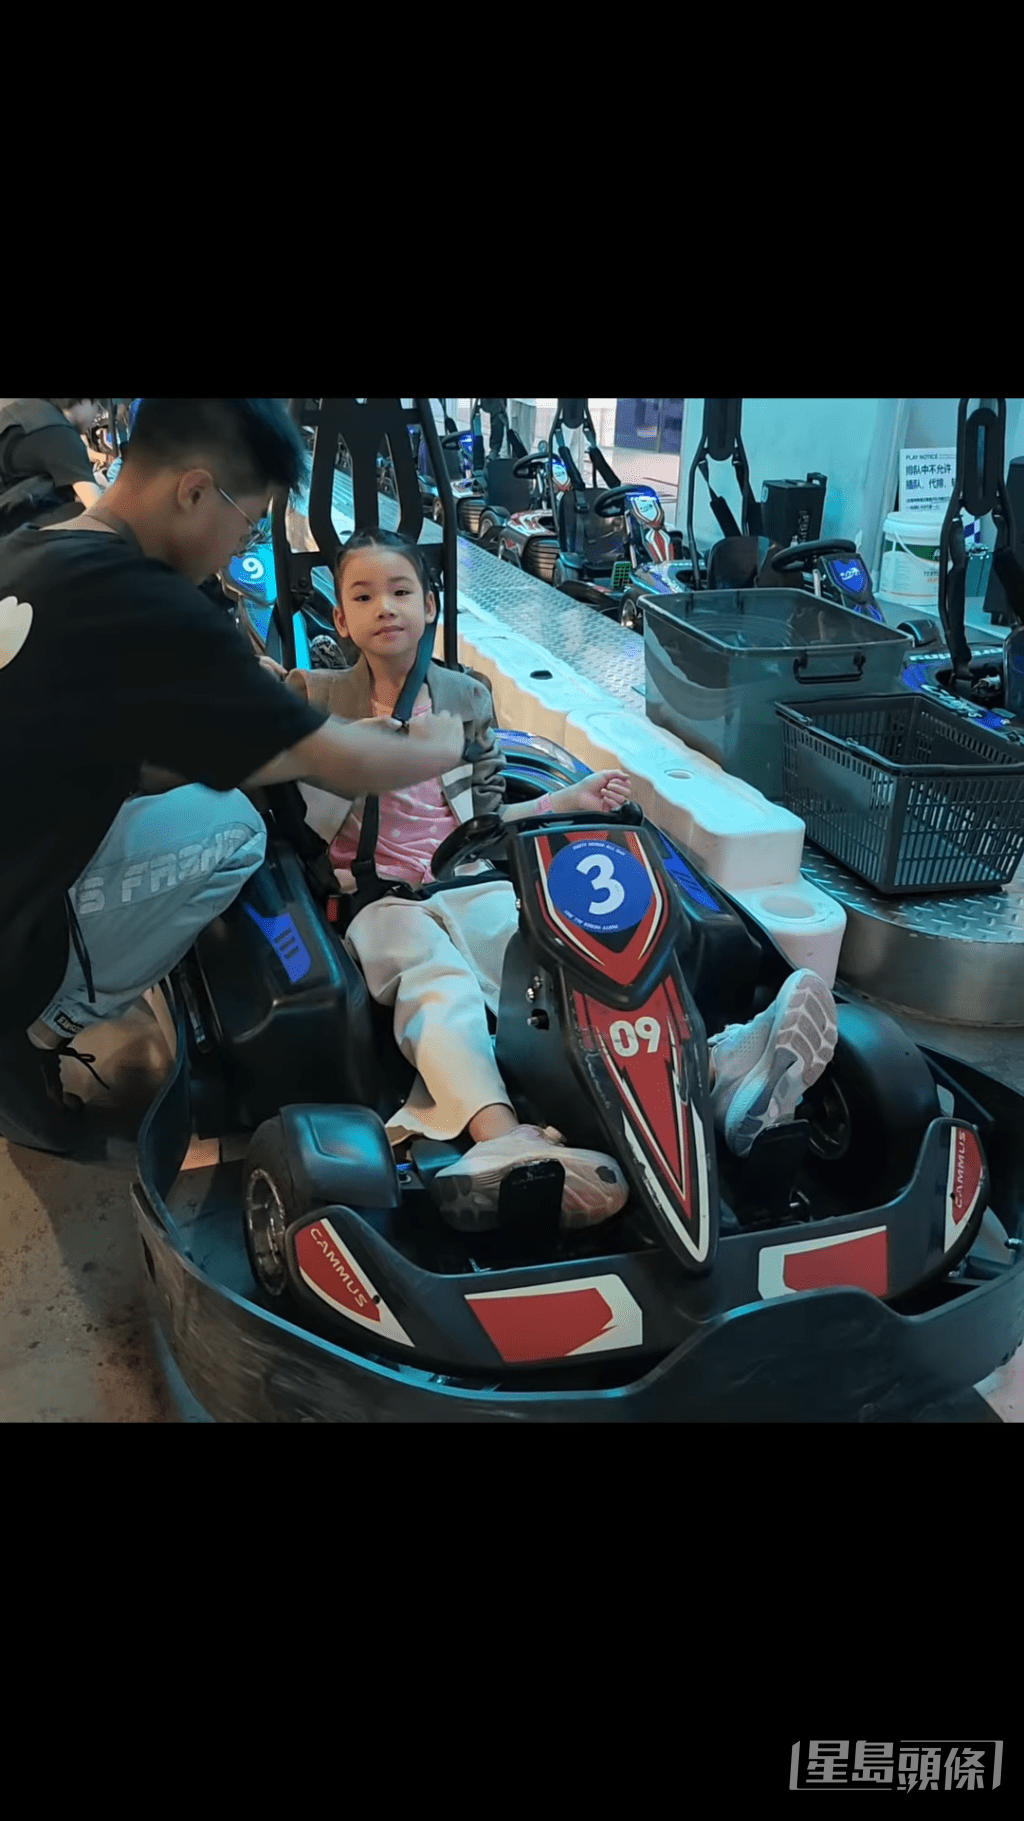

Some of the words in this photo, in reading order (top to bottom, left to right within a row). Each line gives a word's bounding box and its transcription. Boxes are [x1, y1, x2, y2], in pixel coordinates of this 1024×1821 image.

[242, 557, 265, 579] 9
[576, 854, 625, 915] 3
[609, 1016, 661, 1057] 09
[955, 1130, 966, 1209] CAMMUS
[310, 1228, 368, 1307] CAMMUS
